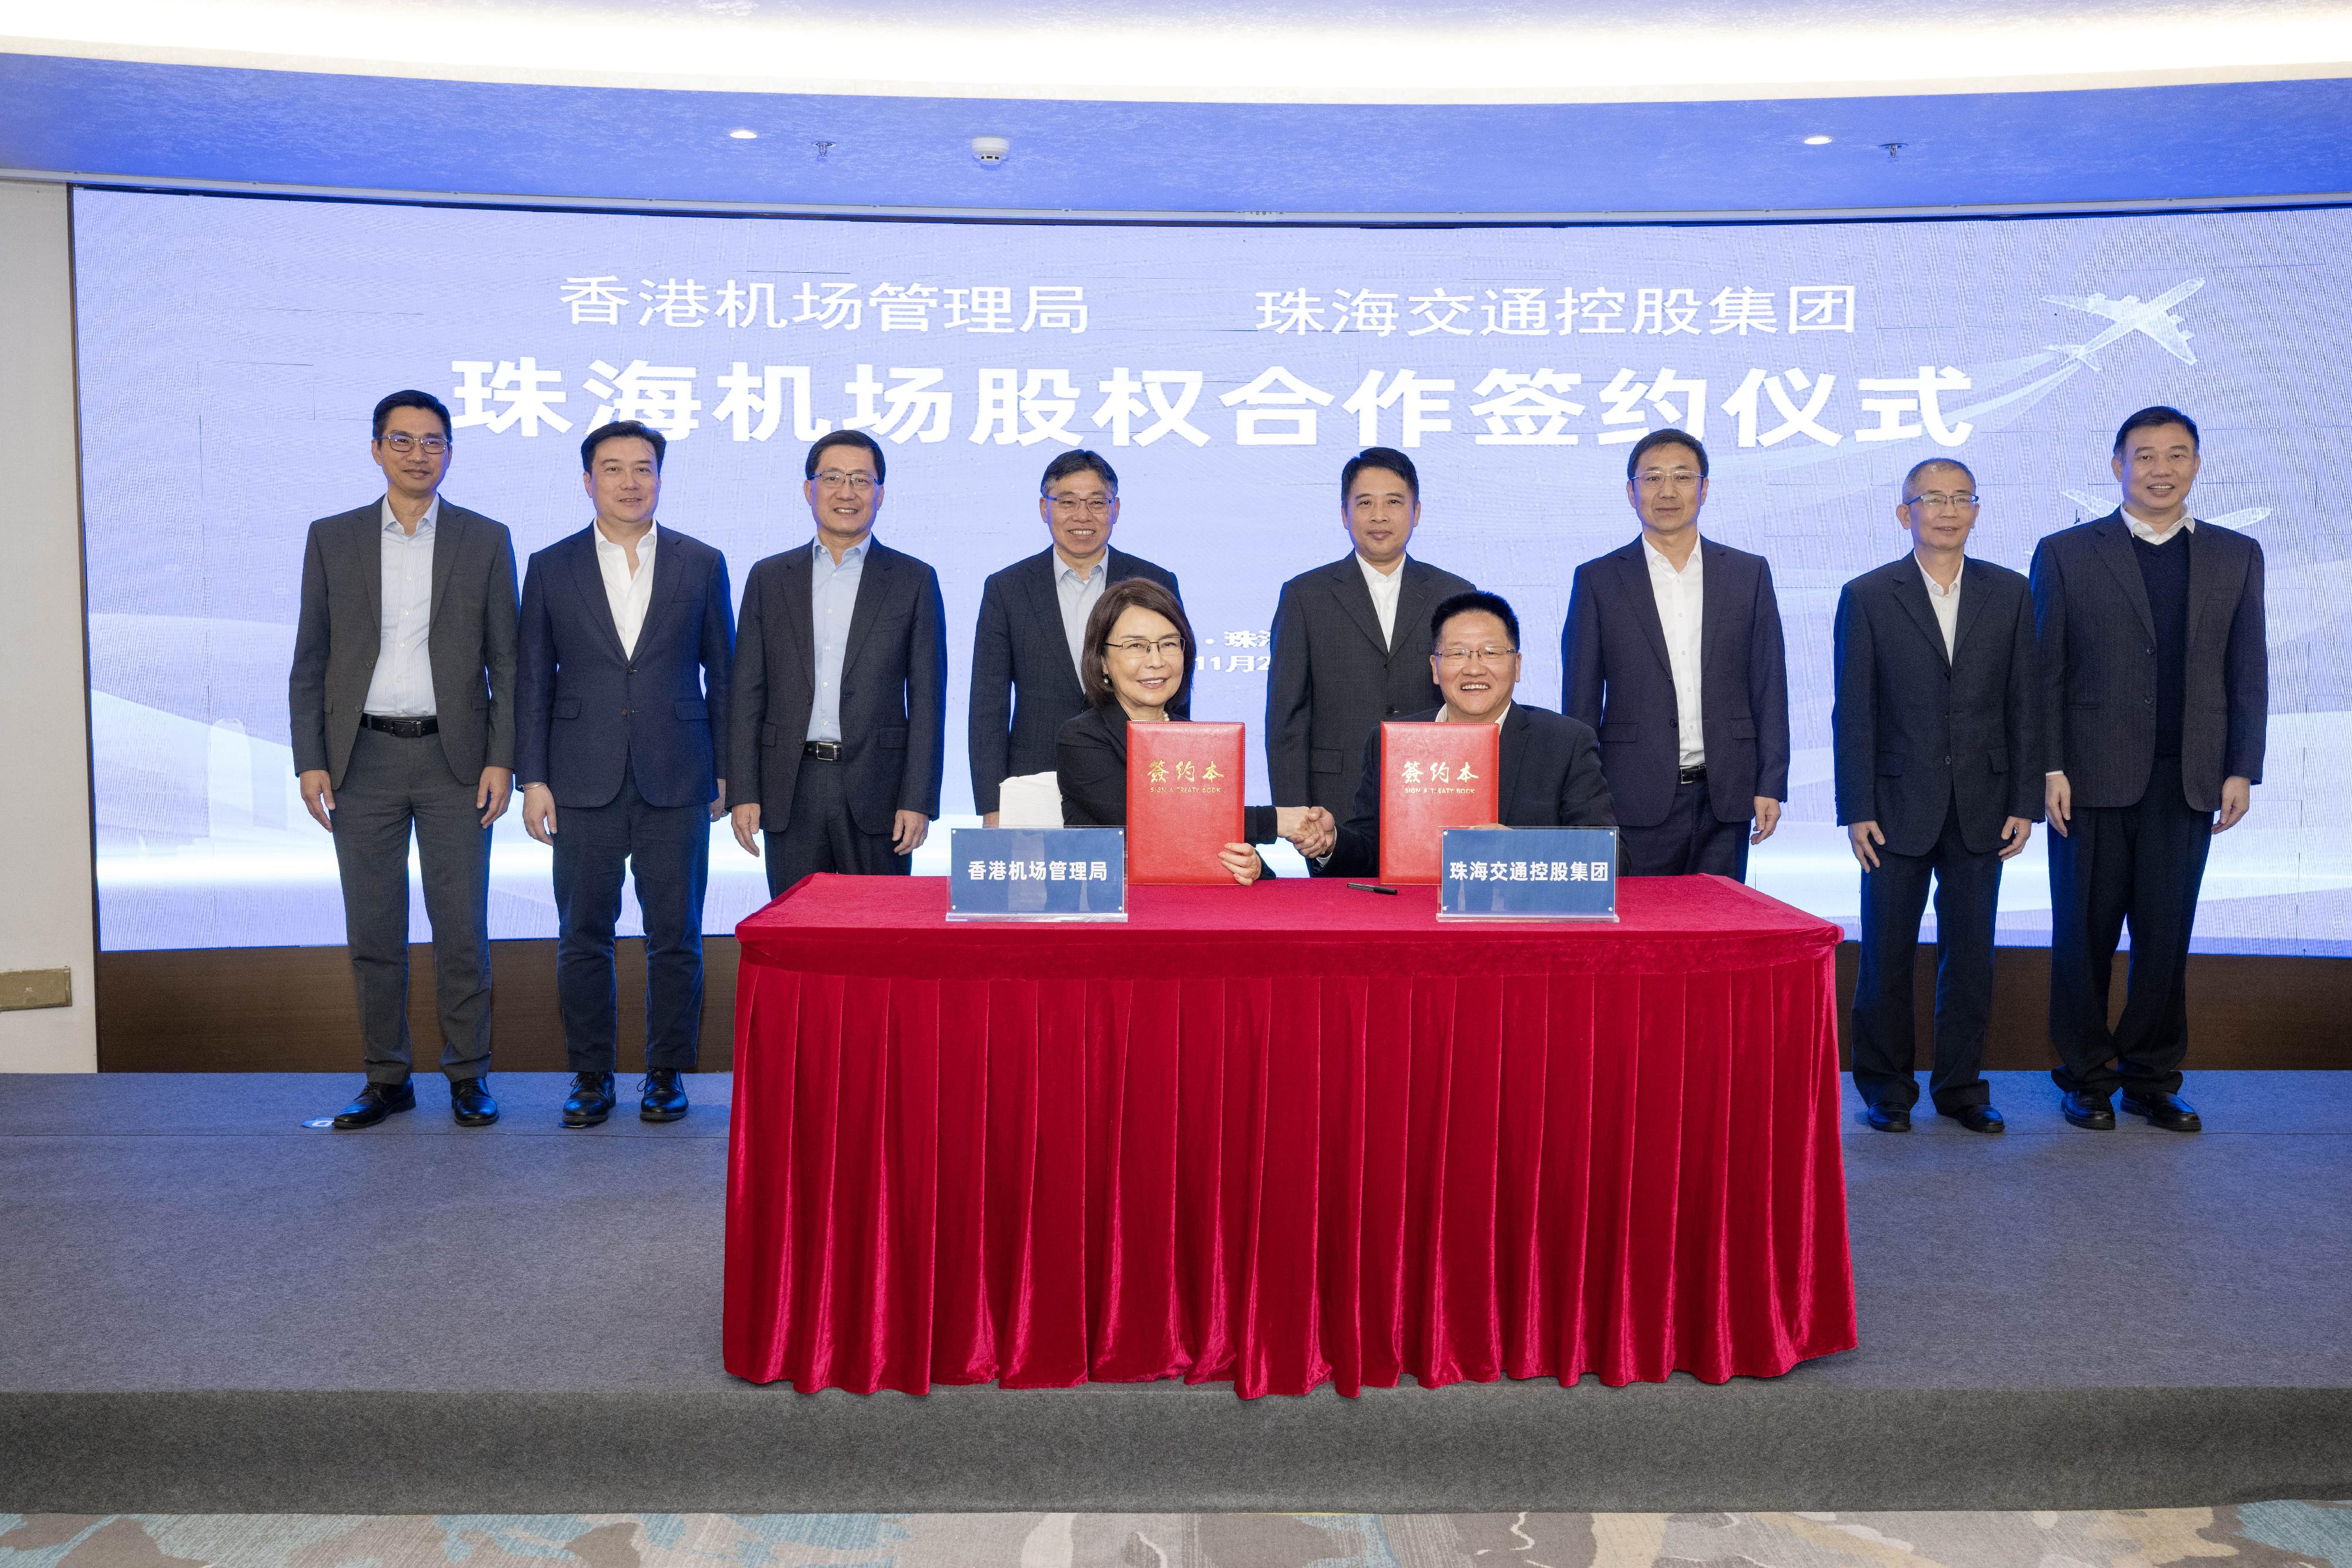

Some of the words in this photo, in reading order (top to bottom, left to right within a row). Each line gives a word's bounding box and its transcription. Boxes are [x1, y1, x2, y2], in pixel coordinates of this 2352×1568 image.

[559, 275, 1090, 334] 香港机场管理局
[1255, 285, 1856, 337] 珠海交通控股集团
[451, 356, 1974, 447] 珠海机场股权合作签约仪式
[967, 860, 1107, 881] 香港机场管理局
[1449, 861, 1608, 882] 珠海交通控股集团
